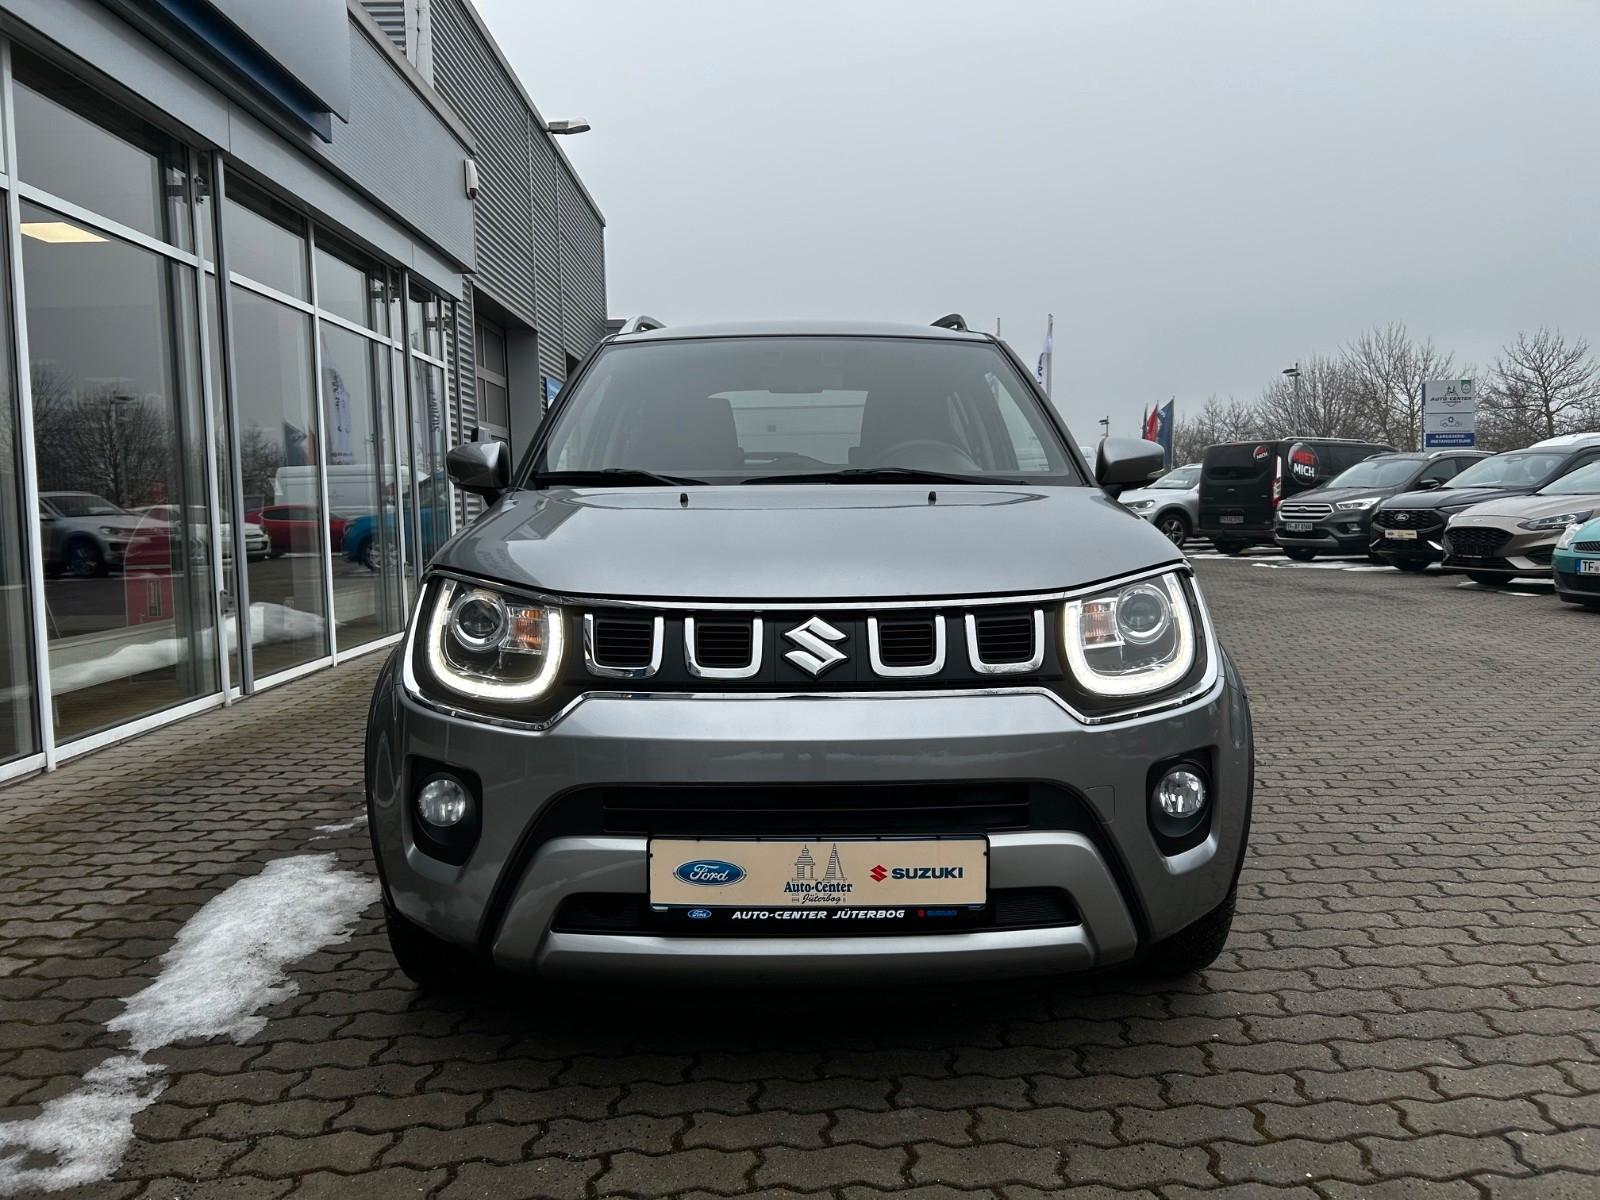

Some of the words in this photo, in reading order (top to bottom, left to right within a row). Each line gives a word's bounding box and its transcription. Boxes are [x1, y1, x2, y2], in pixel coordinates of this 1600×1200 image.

[1293, 463, 1315, 477] MICH
[689, 864, 730, 881] Ford
[891, 867, 963, 880] SUZUKI
[801, 893, 841, 904] Jüterbog
[731, 911, 827, 920] AUTO-CENTER
[832, 909, 905, 919] JÜTERBOG
